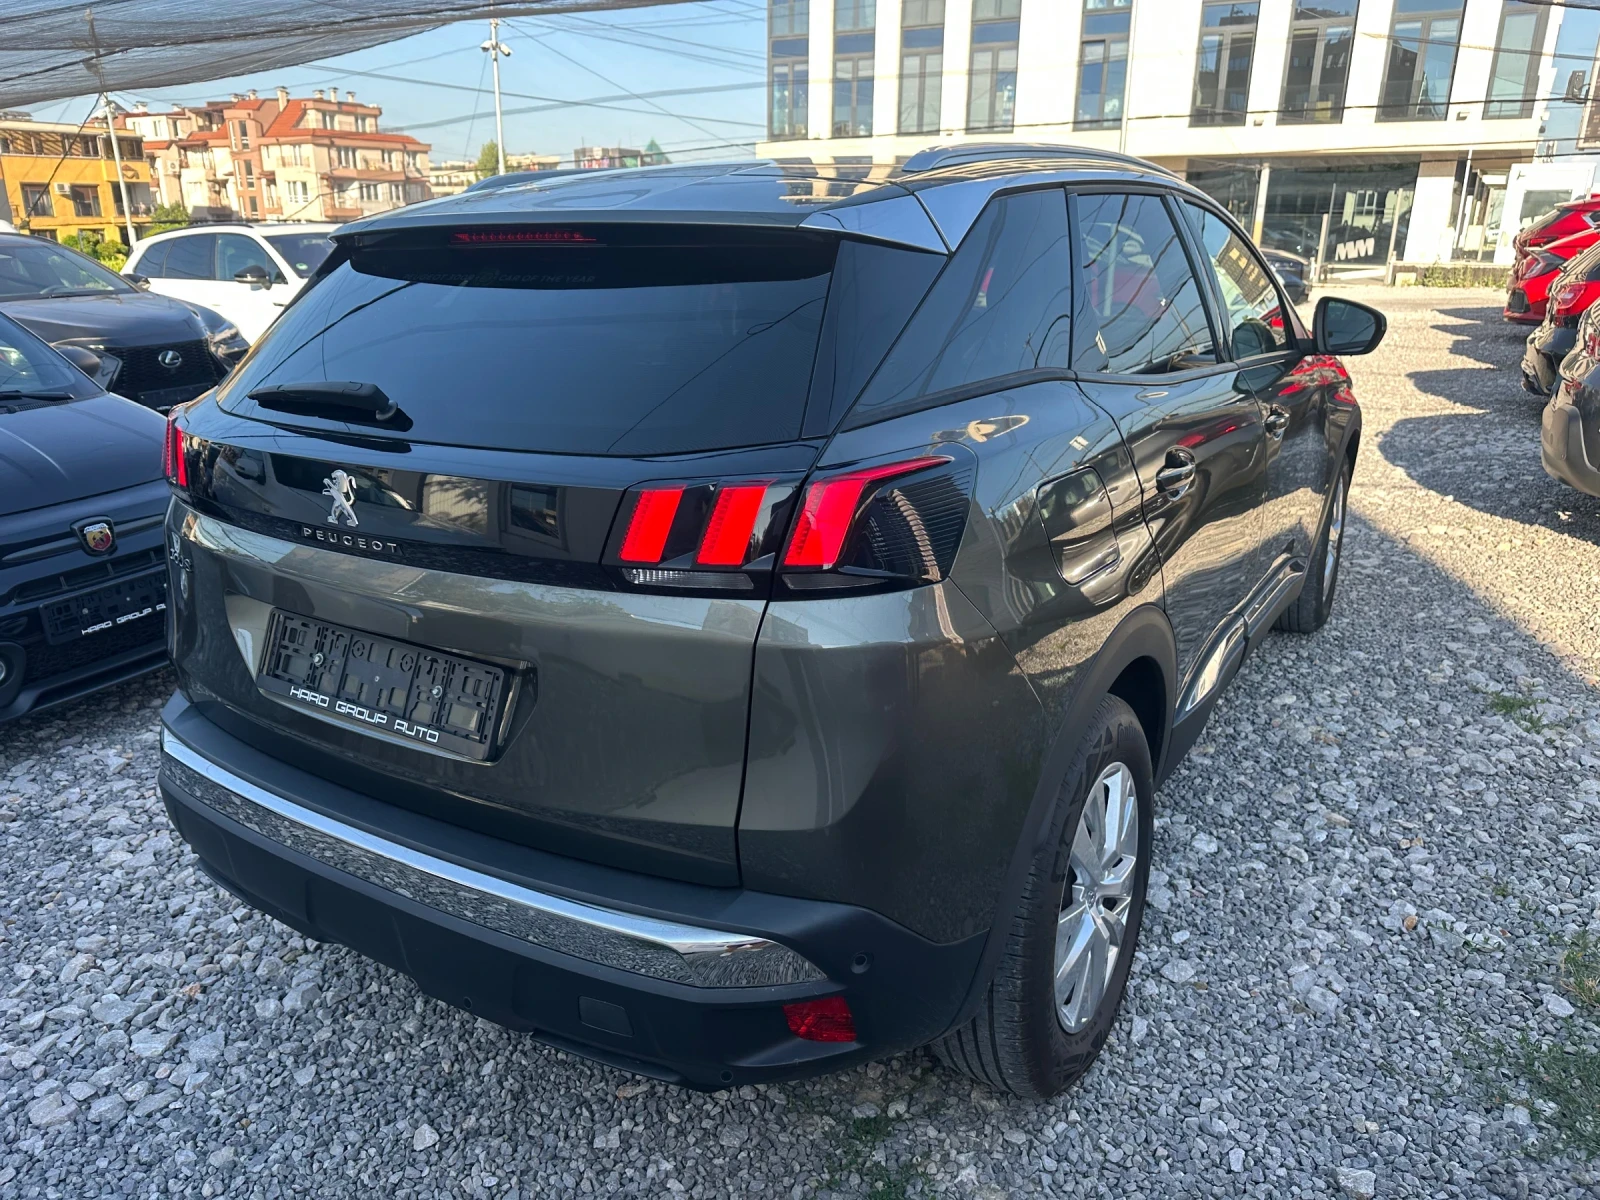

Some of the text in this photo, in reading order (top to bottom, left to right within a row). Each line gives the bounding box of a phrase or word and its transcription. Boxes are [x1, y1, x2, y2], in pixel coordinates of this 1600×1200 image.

[303, 527, 397, 553] PEUGEOT
[81, 620, 112, 635] HARD
[116, 607, 152, 624] GROUP
[290, 685, 440, 743] HARD GROUP AUTO
